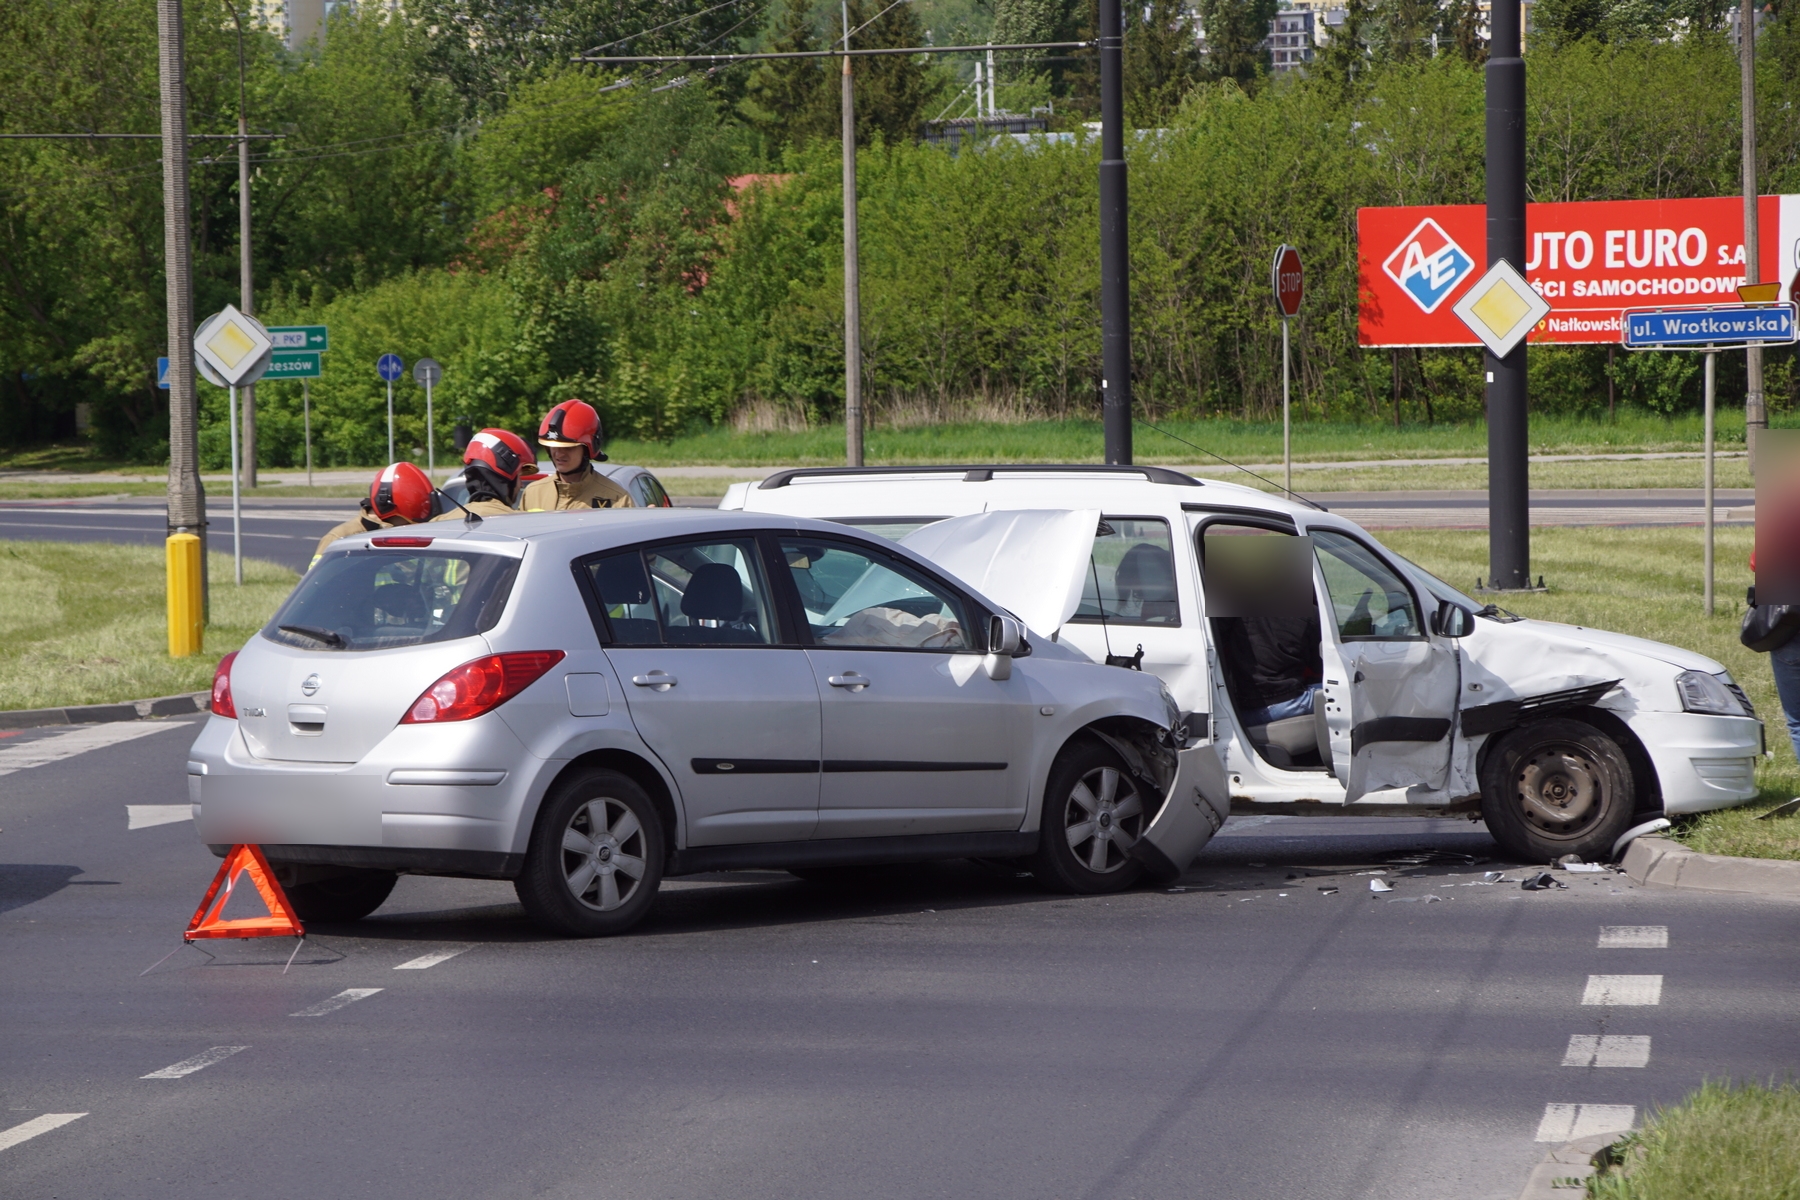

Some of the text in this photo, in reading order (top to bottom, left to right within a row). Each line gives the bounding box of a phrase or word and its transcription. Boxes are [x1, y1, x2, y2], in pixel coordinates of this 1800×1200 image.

[1526, 230, 1594, 270] UTO
[1605, 227, 1708, 268] EURO
[1281, 272, 1301, 293] STOP
[1530, 277, 1566, 297] ŚCI
[1633, 315, 1778, 337] ul. Wrotkowska
[283, 334, 302, 345] PKP
[268, 358, 312, 371] zeszów
